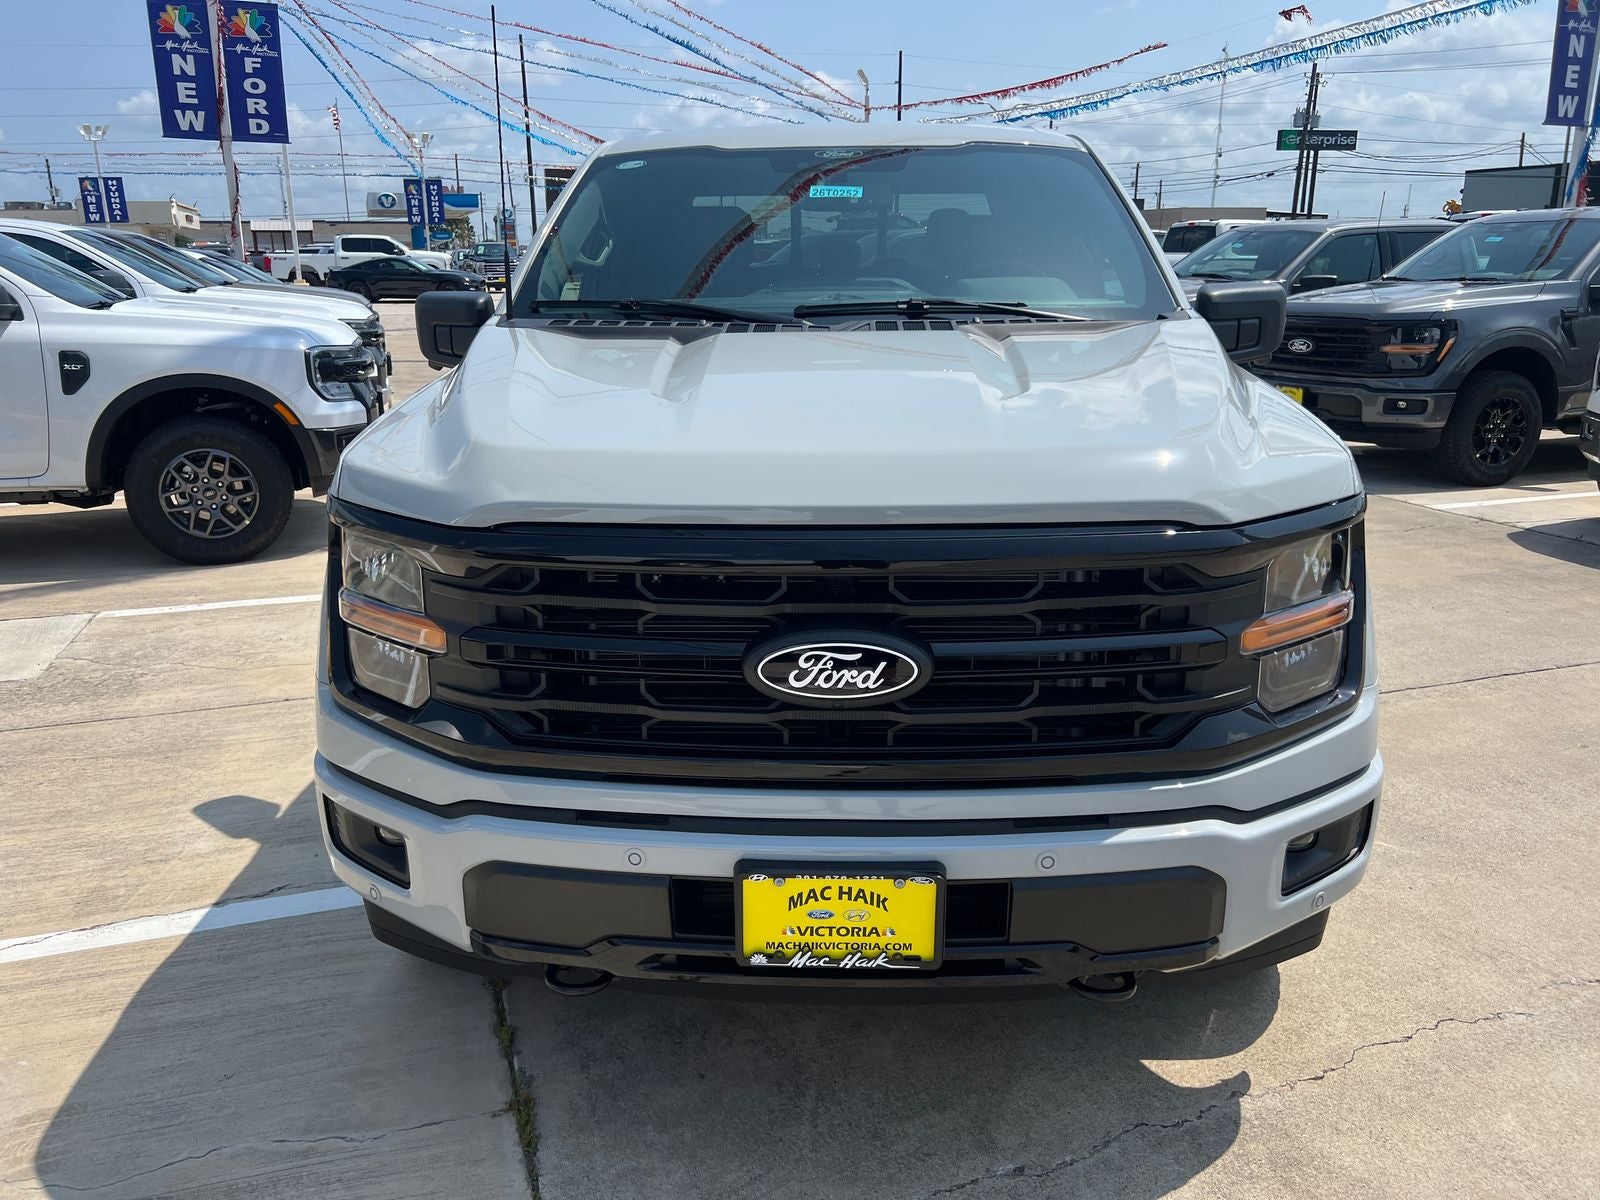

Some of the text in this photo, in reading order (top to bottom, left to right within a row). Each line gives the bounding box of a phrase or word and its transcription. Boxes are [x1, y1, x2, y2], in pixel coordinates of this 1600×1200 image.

[160, 40, 204, 52] Mac Haik
[231, 43, 274, 55] Mac Haik
[1557, 34, 1585, 118] NEW
[171, 53, 205, 132] NEW
[243, 57, 270, 135] FORD
[108, 180, 122, 221] HYUNDAI
[430, 185, 440, 223] HYUNDAI
[811, 188, 859, 197] 26T0252
[87, 196, 100, 221] NEW
[411, 199, 421, 223] NEW
[788, 650, 887, 689] Ford
[787, 885, 889, 912] MAC HAIK
[796, 926, 881, 938] VICTORIA
[765, 941, 913, 951] MACHAIKVICTORIA.COM
[786, 951, 892, 969] Mac Haik
